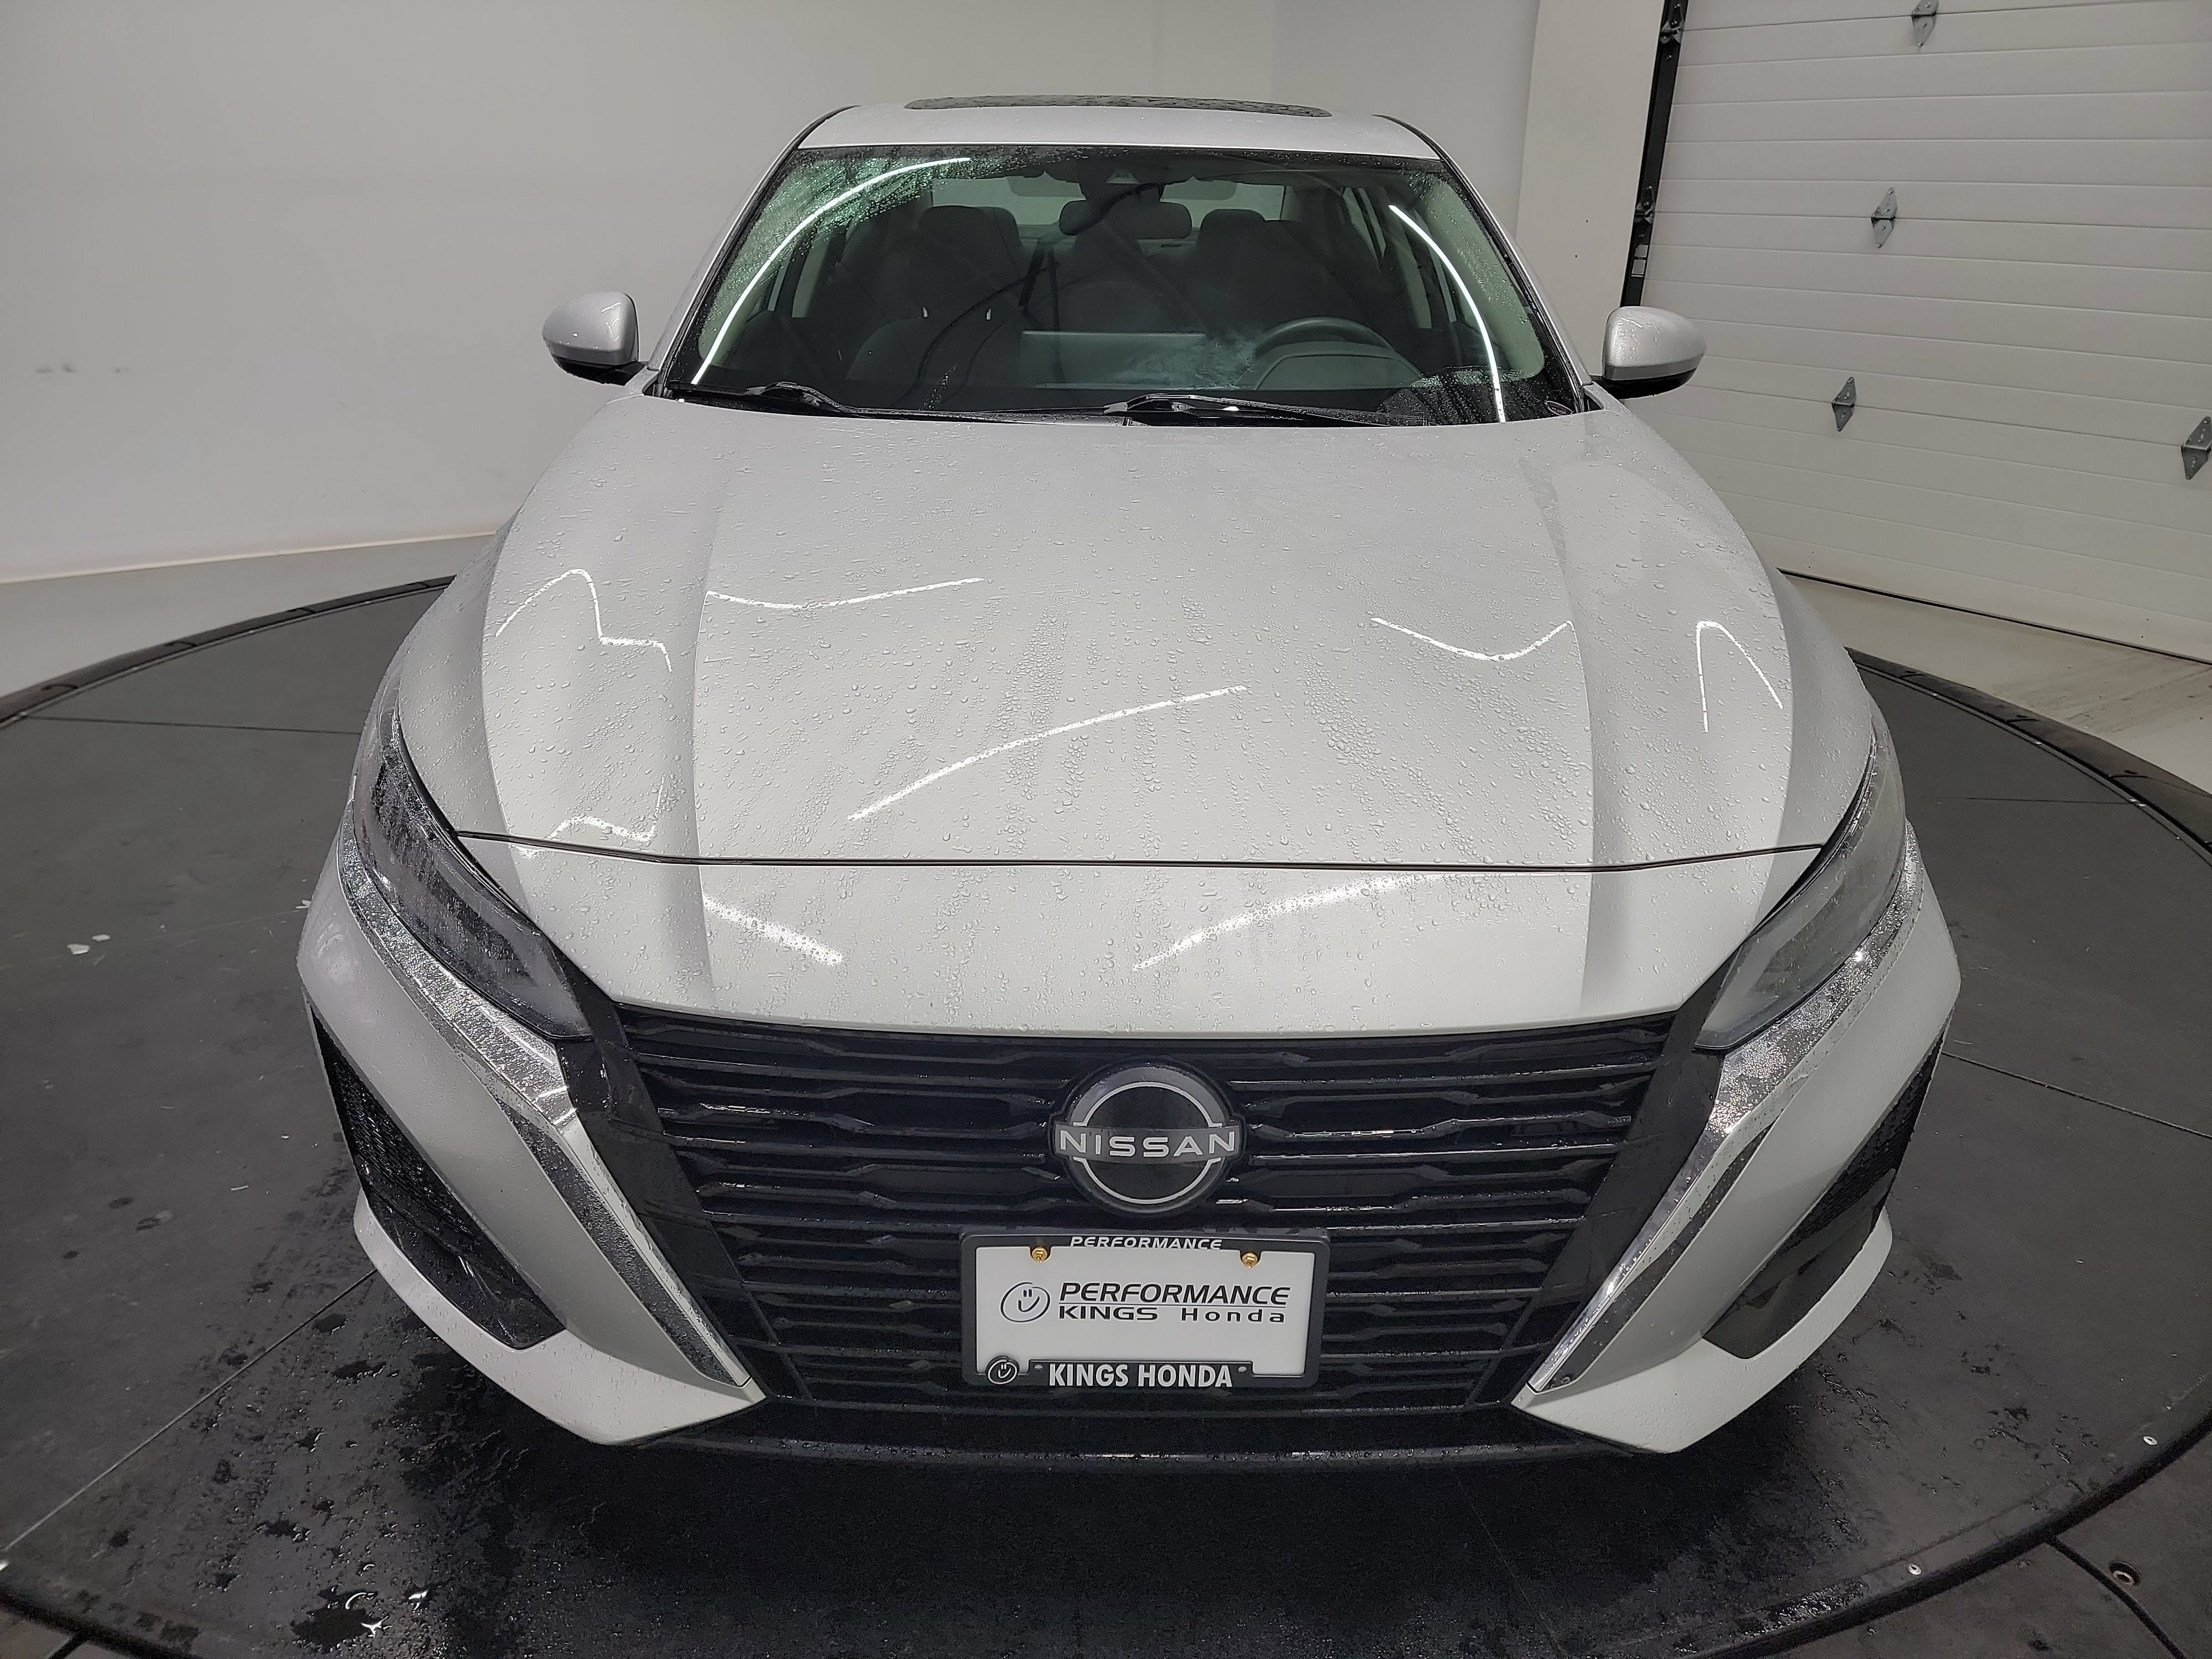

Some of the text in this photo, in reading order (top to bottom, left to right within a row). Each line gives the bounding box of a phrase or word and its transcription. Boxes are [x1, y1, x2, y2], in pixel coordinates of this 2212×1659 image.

[1060, 1129, 1235, 1157] NISSAN
[1070, 1235, 1223, 1250] PERFORMANCE
[1059, 1282, 1291, 1305] PERFORMANCE
[1058, 1306, 1285, 1323] KINGS Honda
[1049, 1364, 1233, 1387] KINGS HONDA
